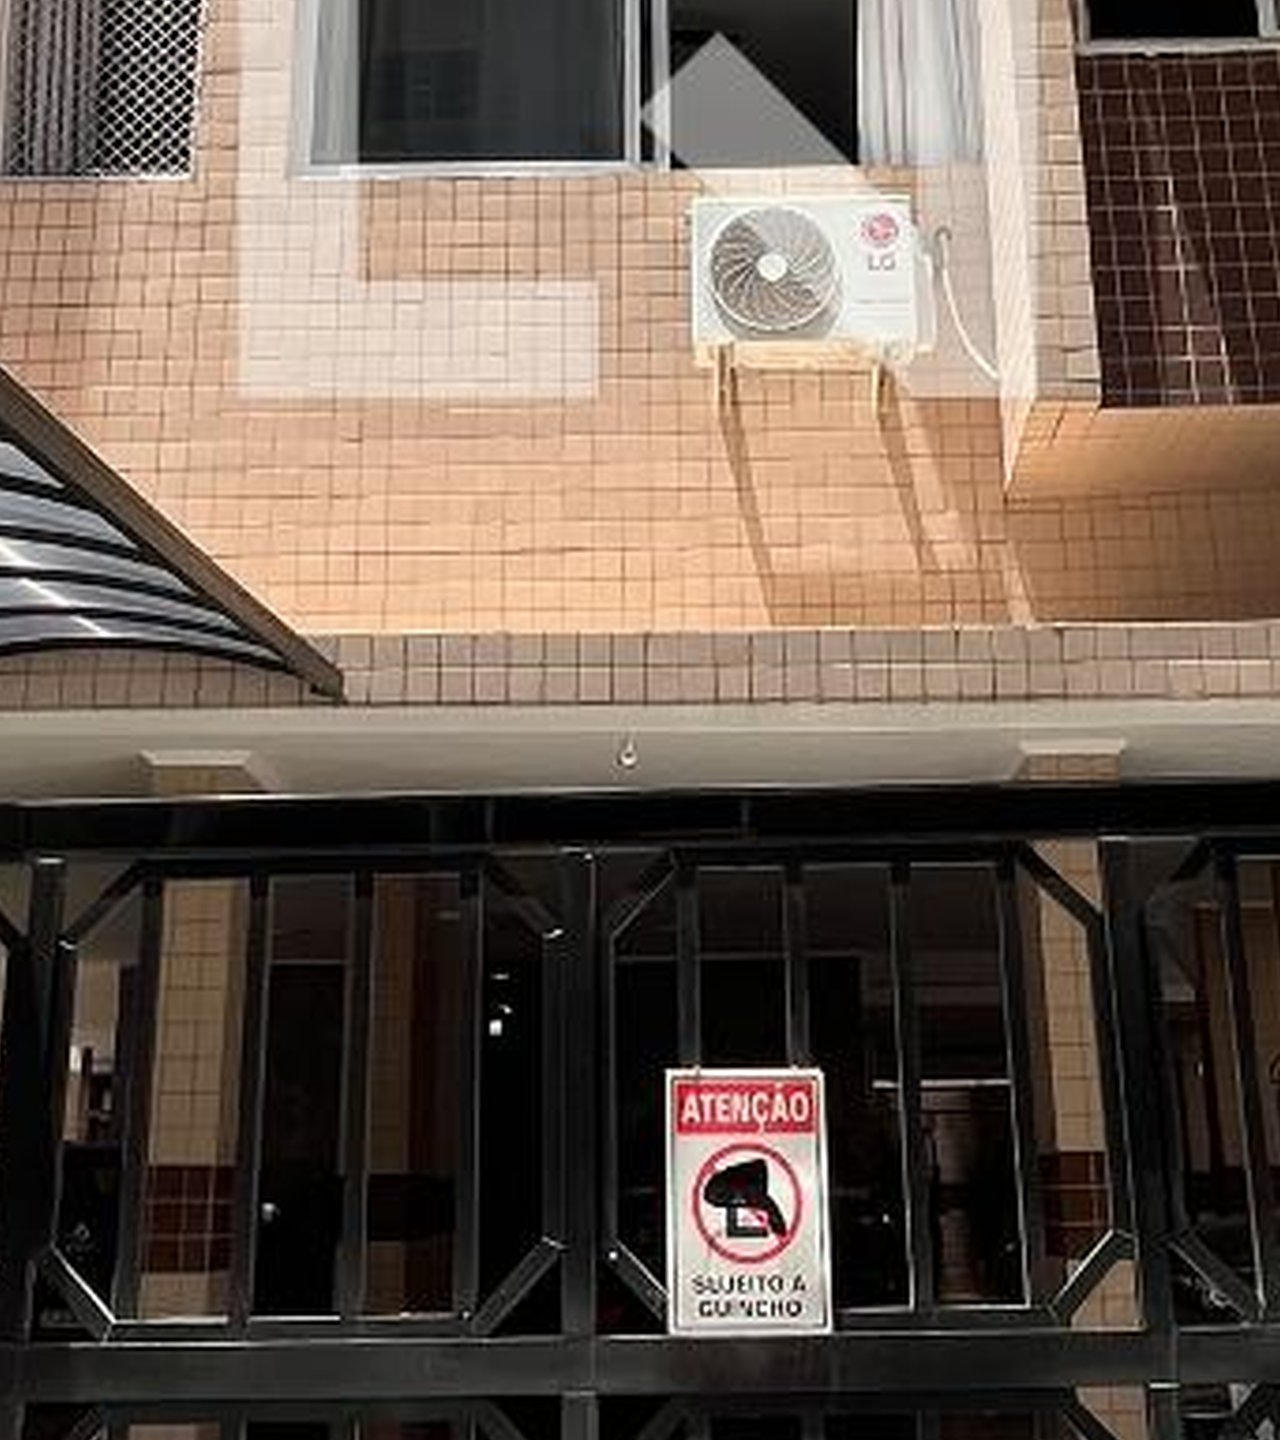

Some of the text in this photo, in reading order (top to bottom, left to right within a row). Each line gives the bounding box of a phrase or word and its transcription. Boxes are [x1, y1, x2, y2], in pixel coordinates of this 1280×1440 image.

[868, 253, 896, 271] LG
[681, 1083, 810, 1132] ATENÇÃO
[691, 1275, 783, 1295] SUJEITO
[699, 1300, 803, 1317] GUINCHO
